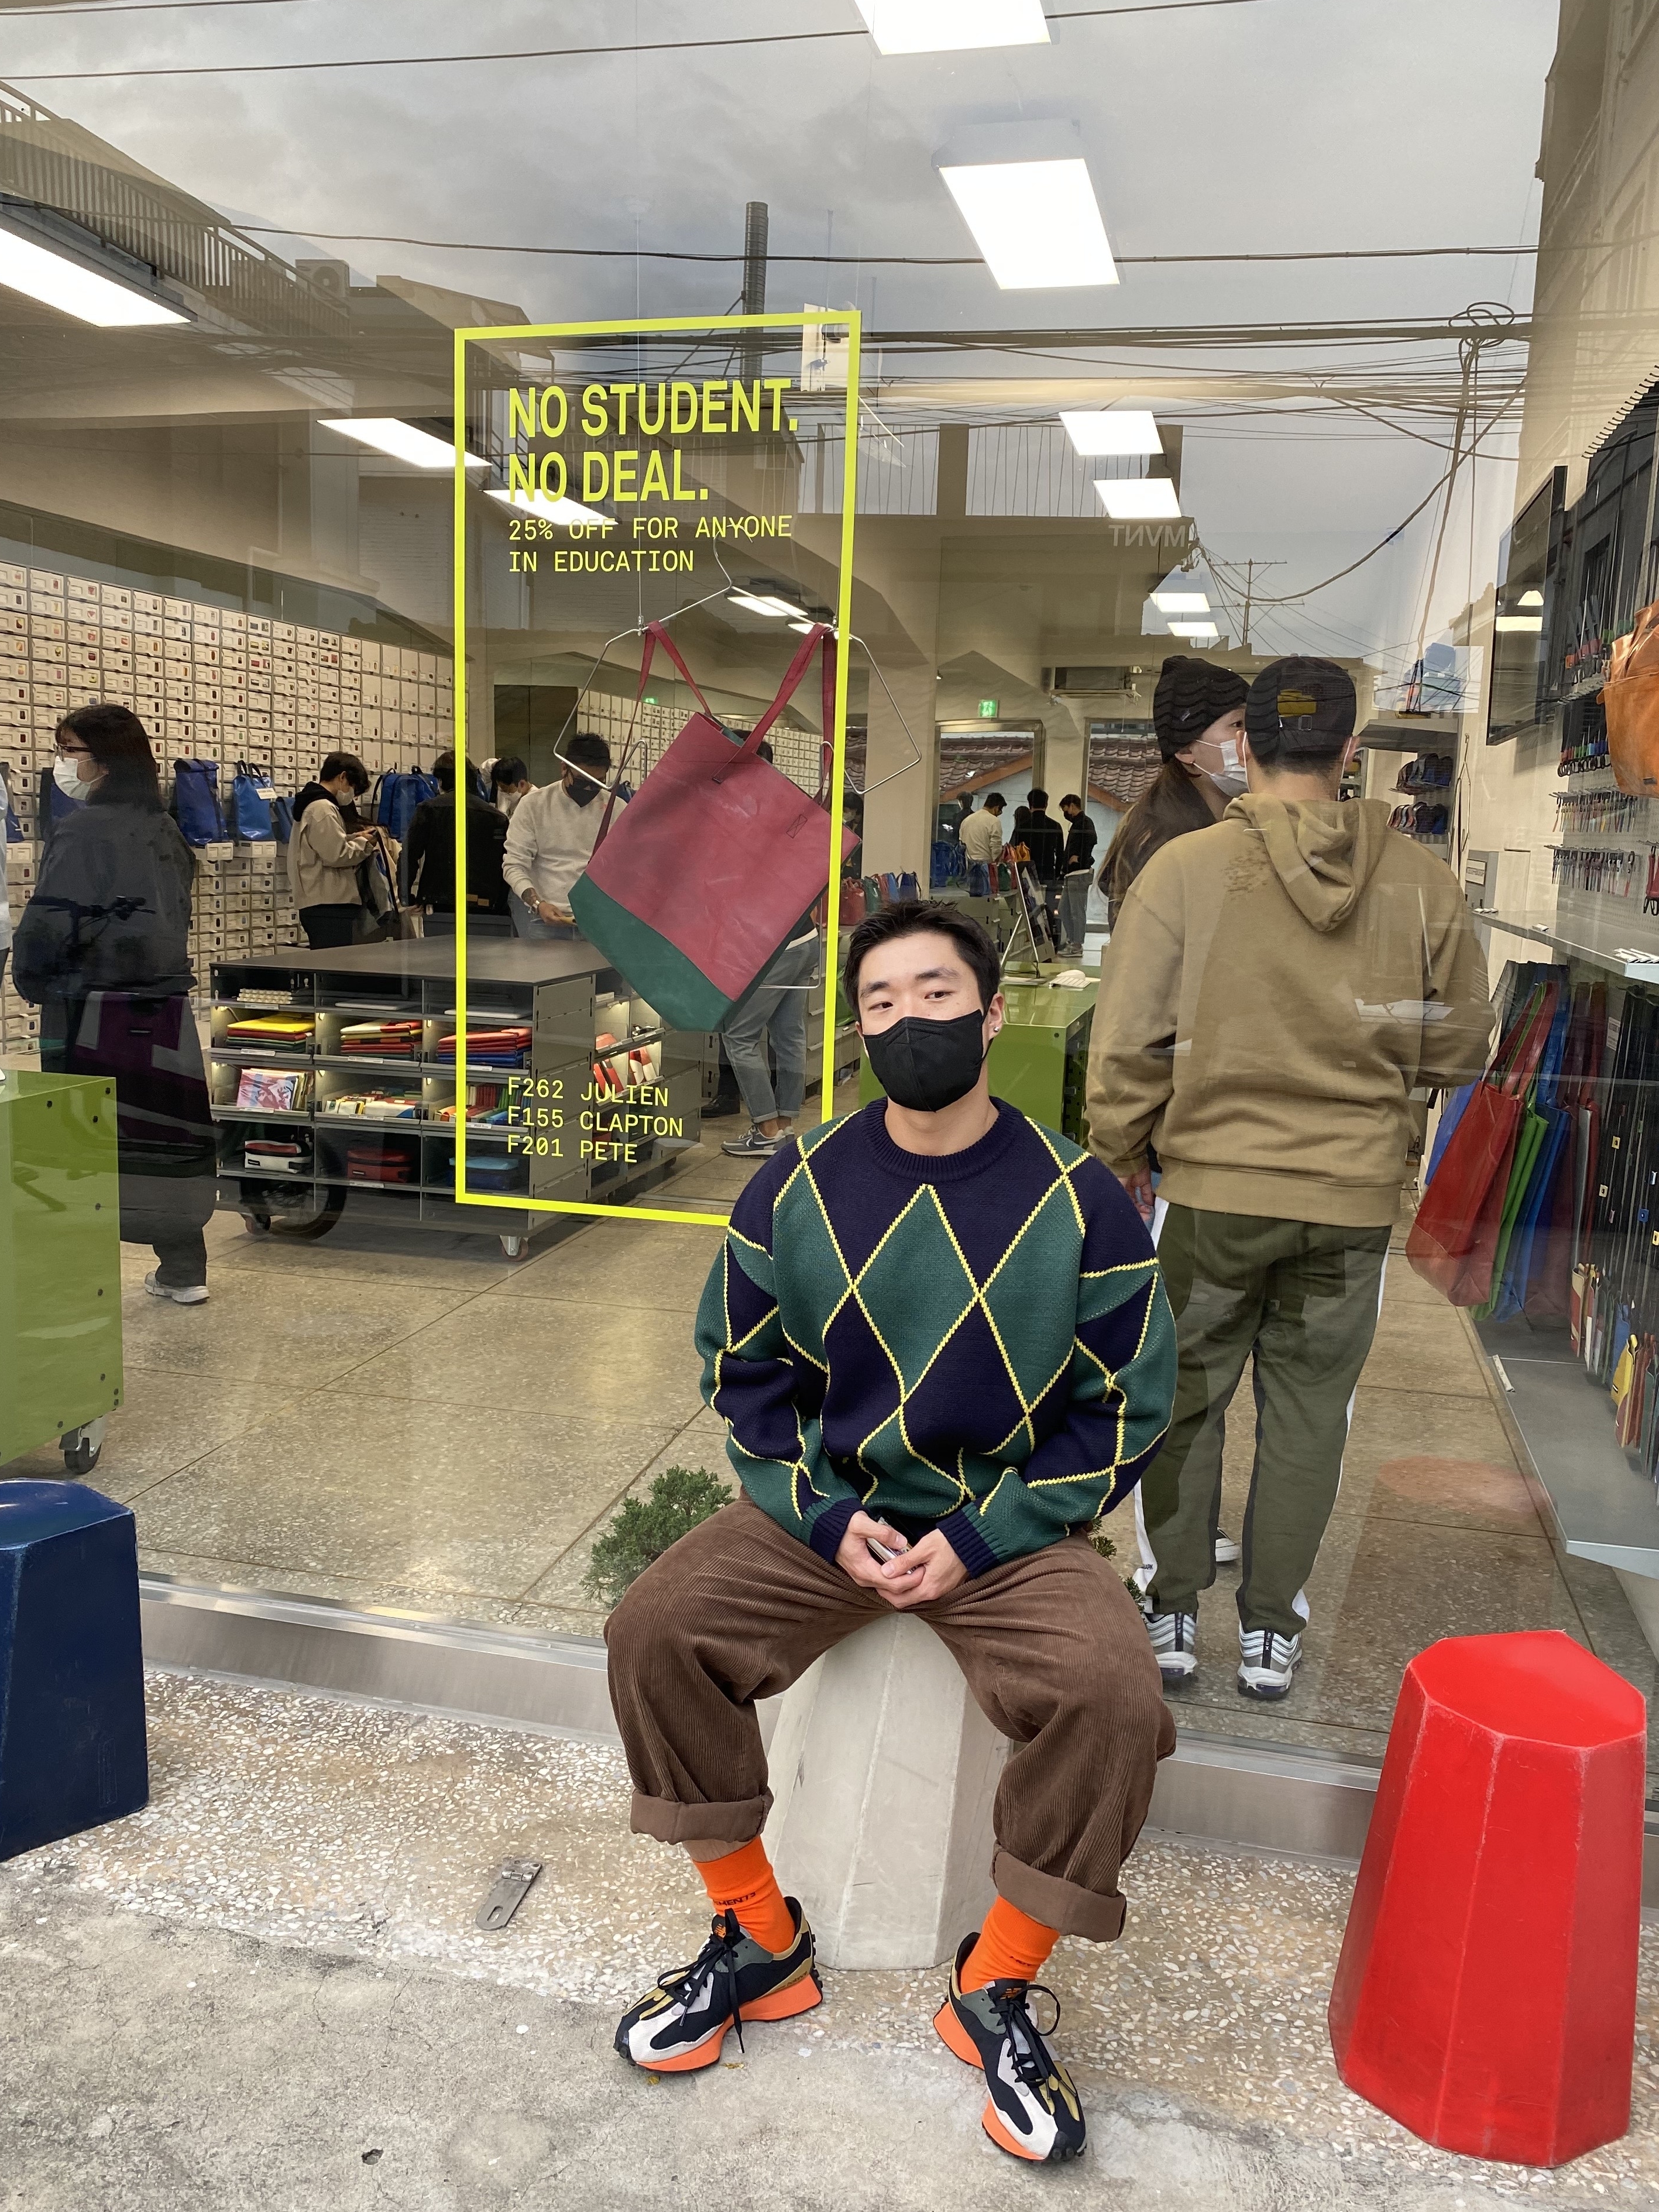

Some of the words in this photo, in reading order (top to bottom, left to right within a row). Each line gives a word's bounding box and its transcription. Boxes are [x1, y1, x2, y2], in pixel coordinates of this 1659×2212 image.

[510, 386, 568, 438] NO
[581, 378, 798, 437] STUDENT.
[509, 451, 567, 503] NO
[583, 449, 708, 502] DEAL.
[509, 518, 554, 540] 25%
[569, 517, 616, 540] OFF
[633, 517, 678, 539] FOR
[695, 515, 792, 539] ANYONE
[509, 551, 537, 572] IN
[554, 550, 693, 572] EDUCATION
[507, 1076, 564, 1099] F262
[580, 1081, 668, 1107] JULIEN
[507, 1105, 564, 1128] F155
[579, 1111, 683, 1137] CLAPTON
[507, 1134, 564, 1157] F201
[580, 1139, 638, 1163] PETE
